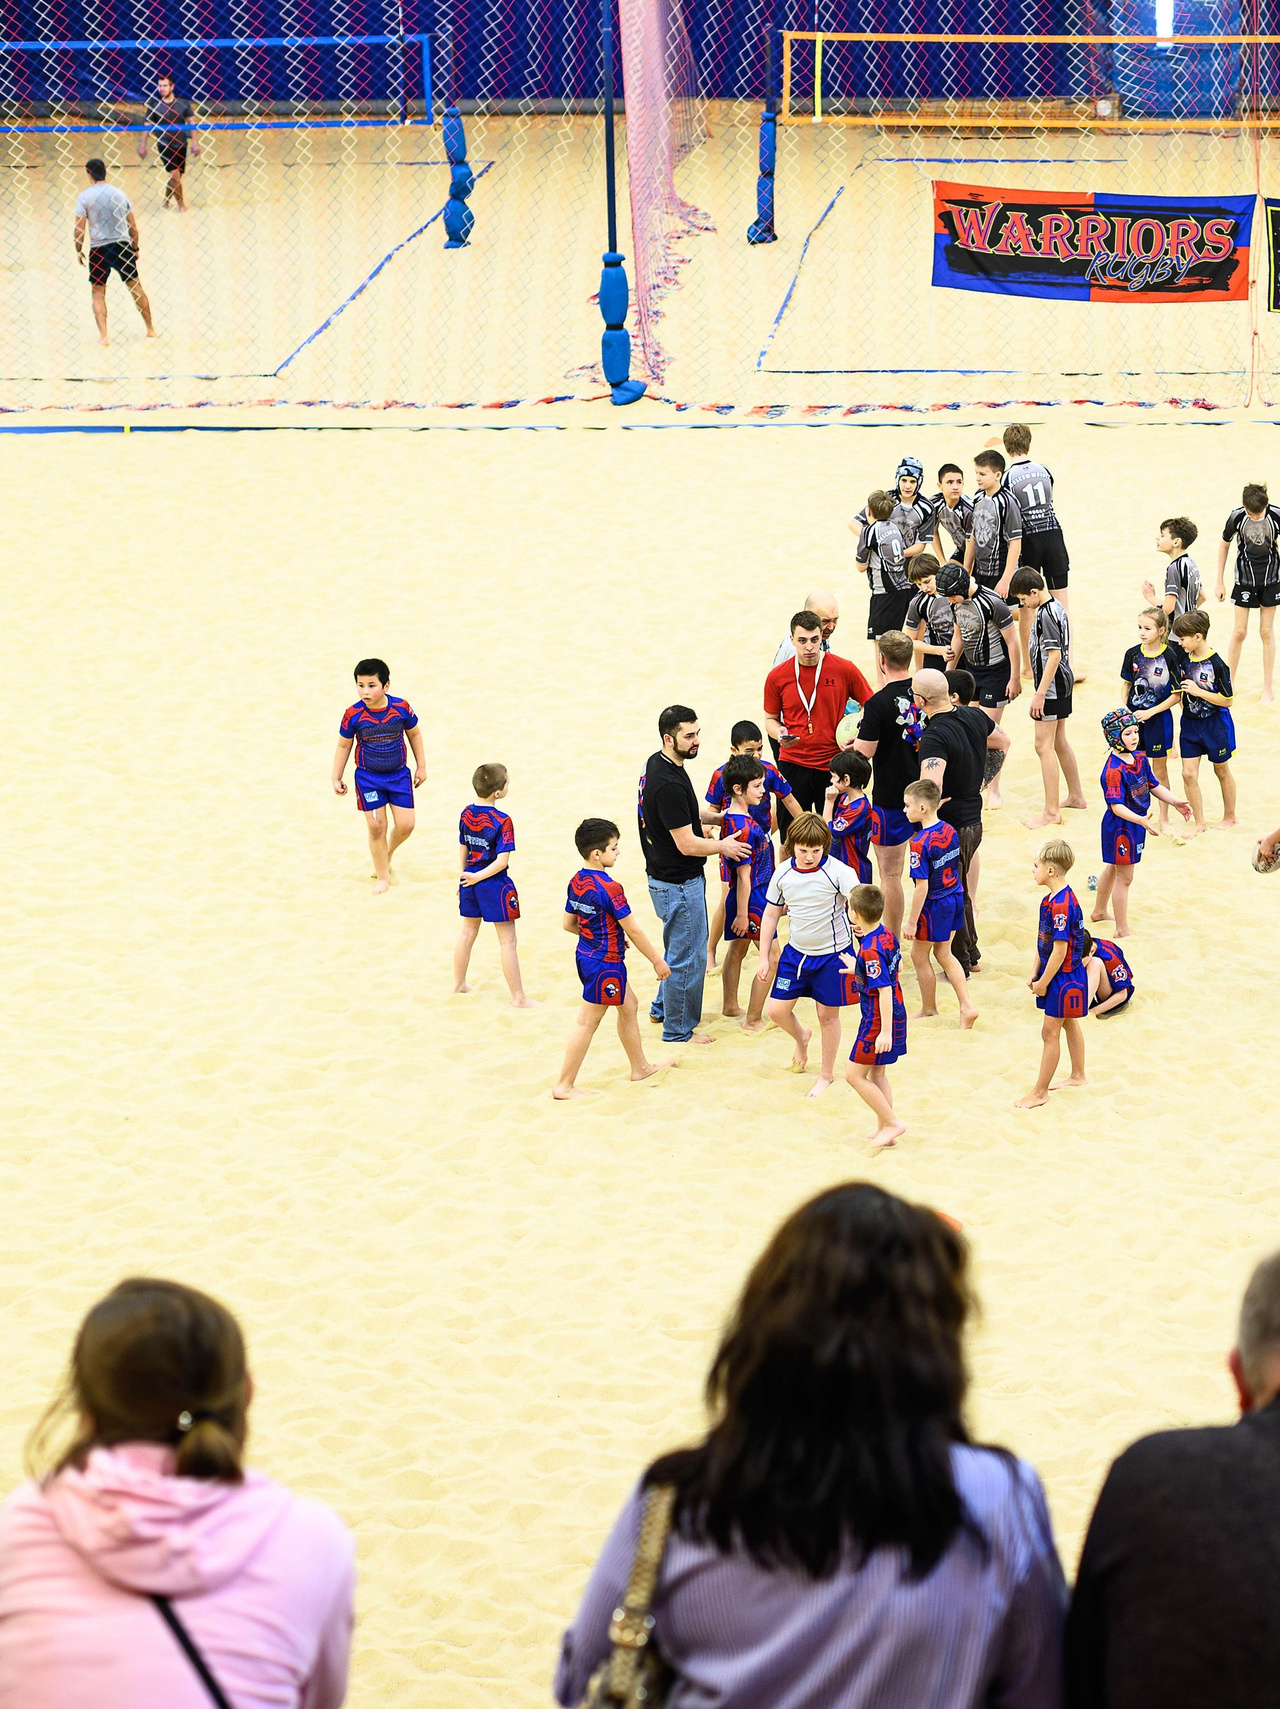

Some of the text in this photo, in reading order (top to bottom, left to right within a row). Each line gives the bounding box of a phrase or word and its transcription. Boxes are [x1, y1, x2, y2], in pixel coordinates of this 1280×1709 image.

[945, 200, 1236, 263] WARRIORS
[1085, 250, 1194, 292] RUGBY
[1022, 480, 1047, 507] 11
[891, 538, 903, 563] 9
[1069, 995, 1080, 1009] 11
